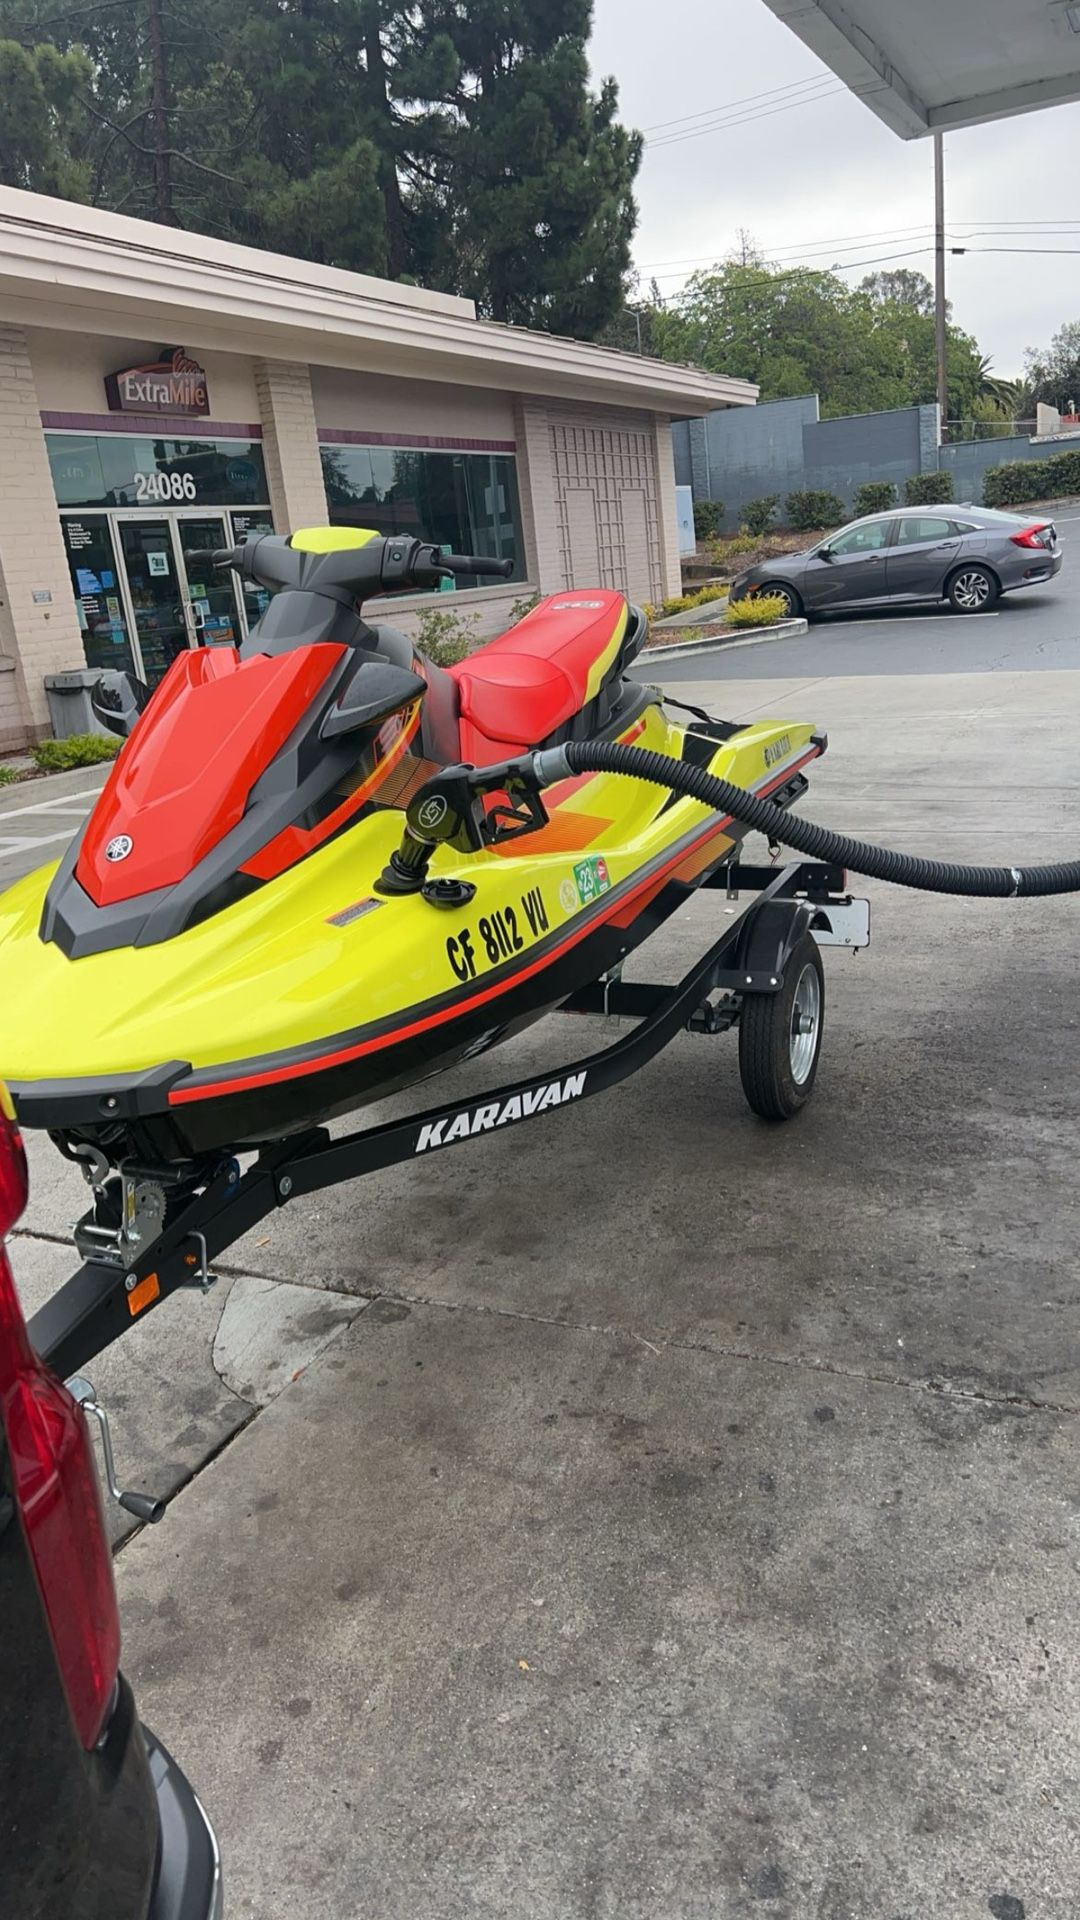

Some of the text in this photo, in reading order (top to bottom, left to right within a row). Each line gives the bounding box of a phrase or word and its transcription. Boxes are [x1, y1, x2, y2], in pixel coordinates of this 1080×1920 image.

[125, 375, 206, 407] ExtraMile
[134, 472, 196, 500] 24086
[580, 867, 594, 893] 23
[446, 928, 477, 982] CF
[478, 906, 524, 965] 8112
[520, 886, 550, 937] VU
[415, 1070, 588, 1153] KARAVAN
